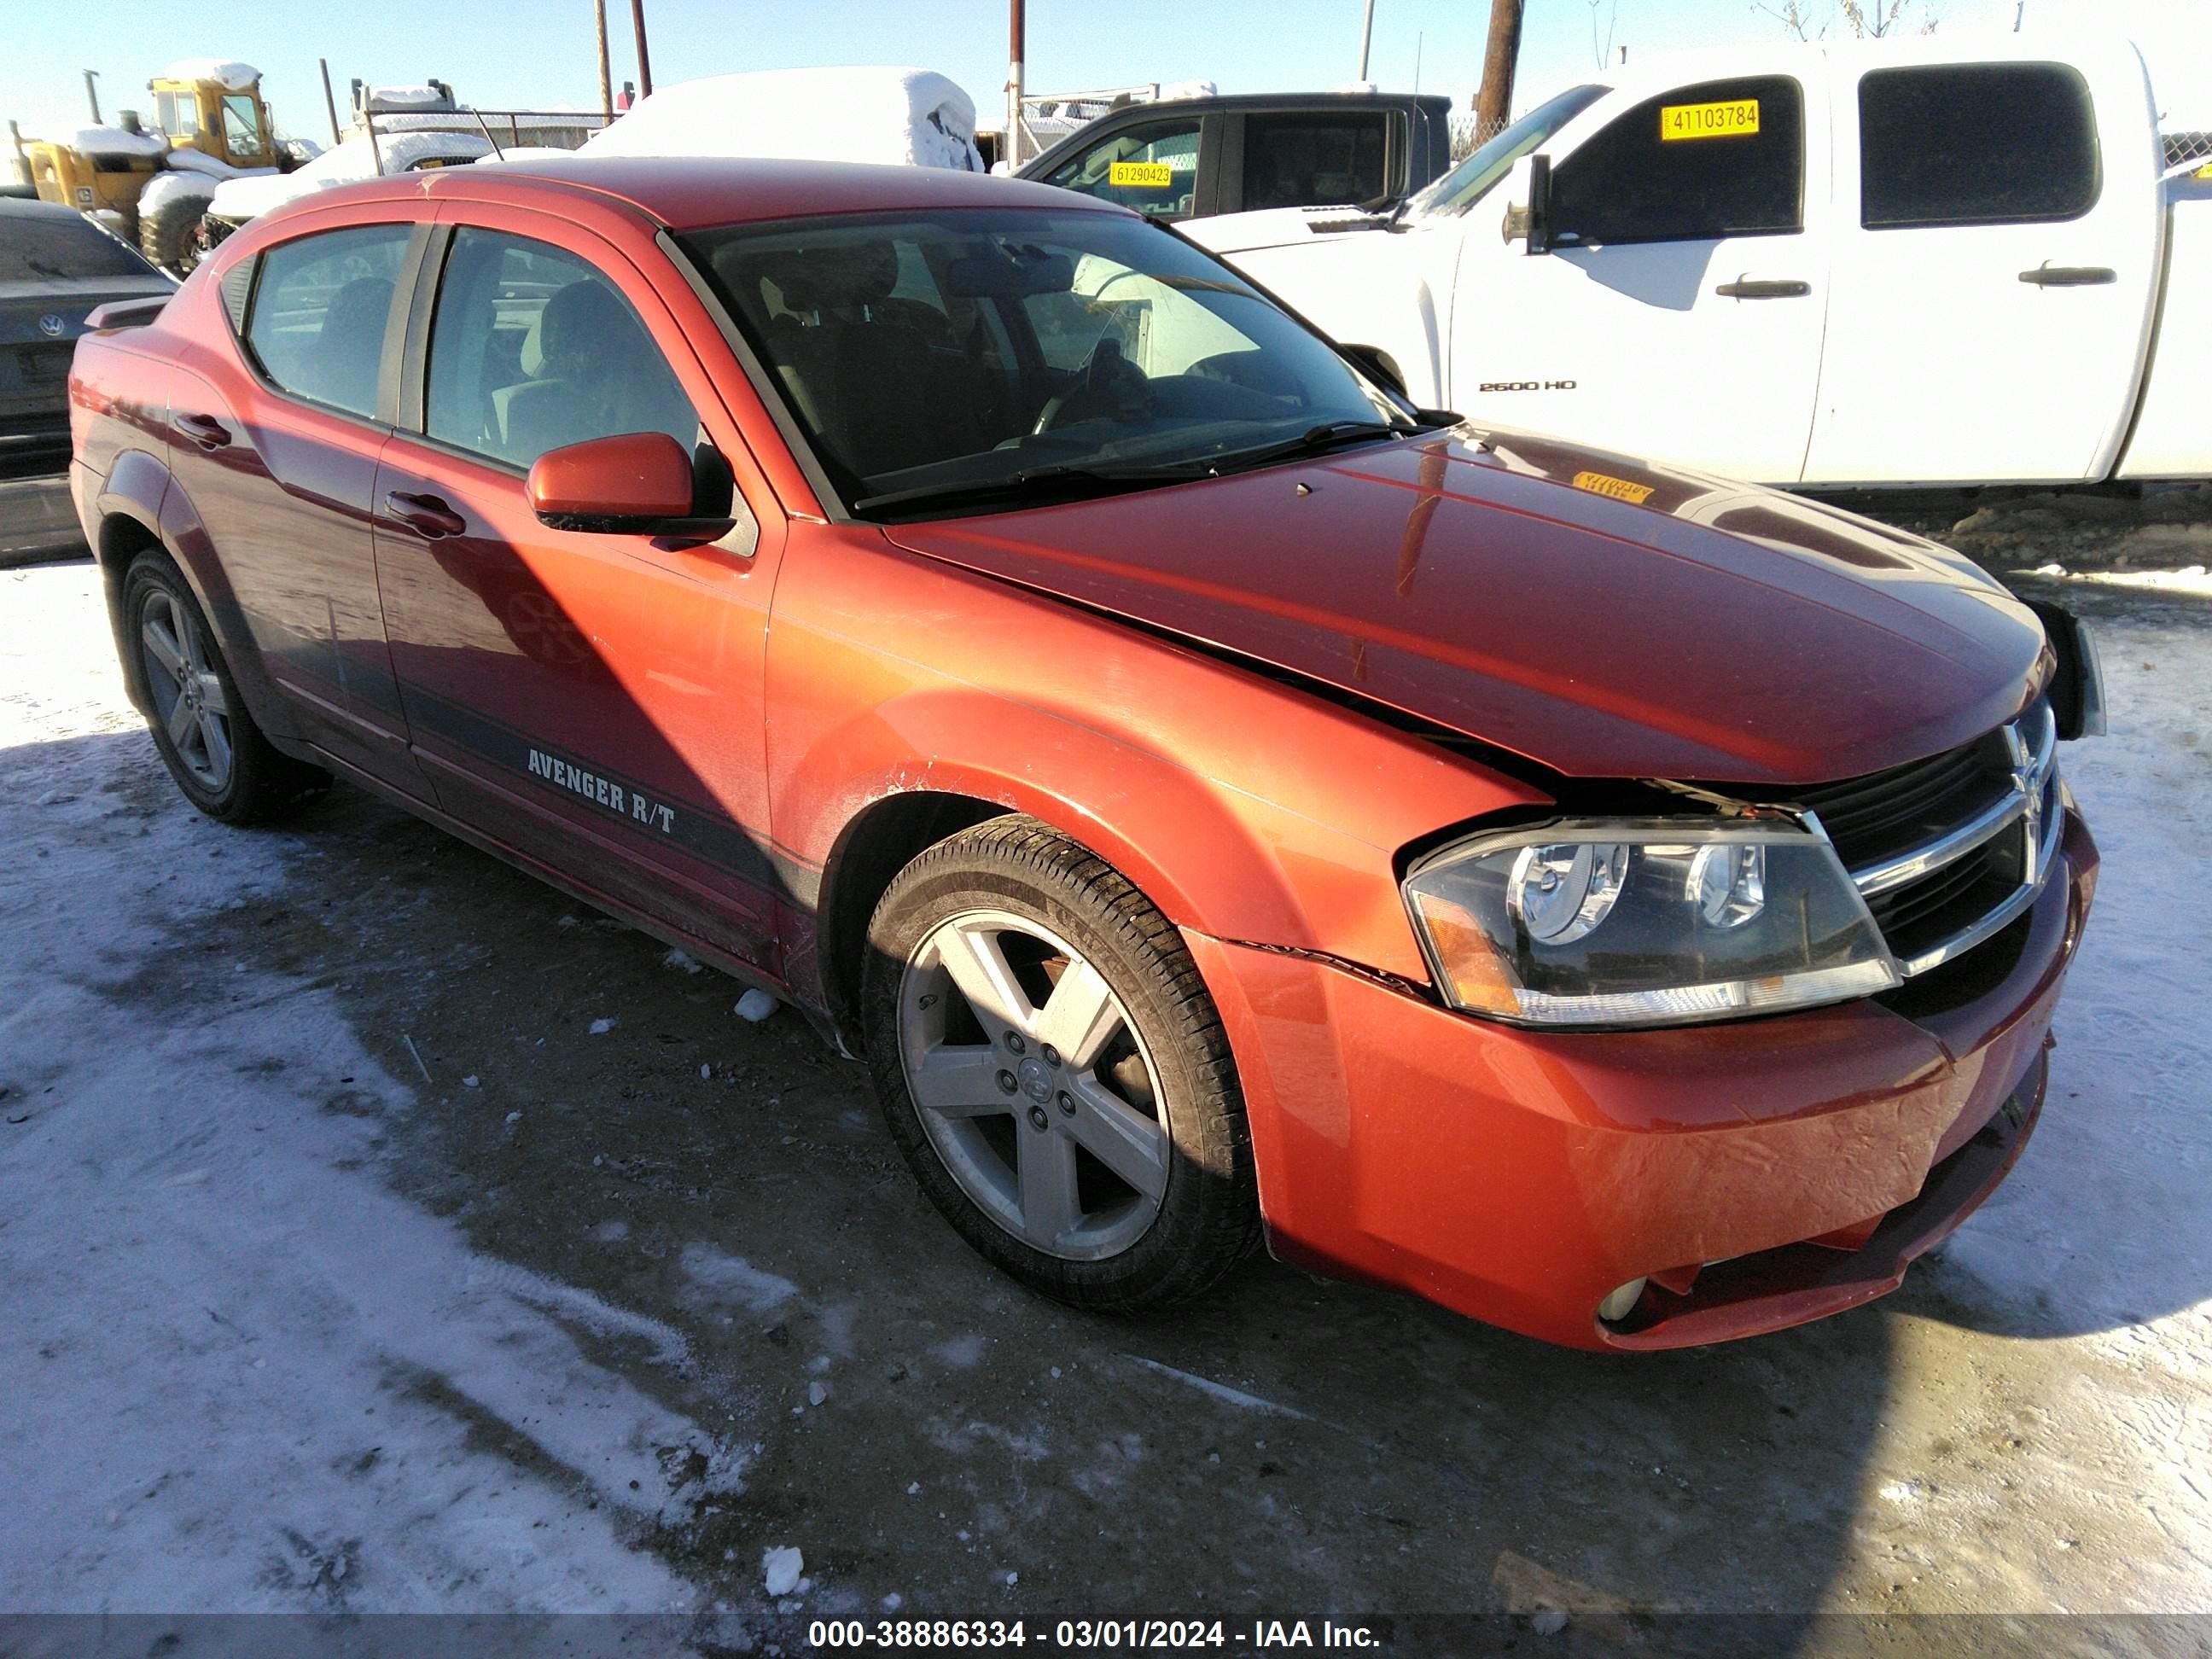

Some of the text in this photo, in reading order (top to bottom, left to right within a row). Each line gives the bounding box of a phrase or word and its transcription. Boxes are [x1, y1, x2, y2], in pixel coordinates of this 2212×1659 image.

[1674, 105, 1757, 131] 41103784
[1117, 166, 1170, 182] 61290423
[1479, 381, 1577, 393] 2500 HD
[528, 748, 675, 834] AVENGER R/T
